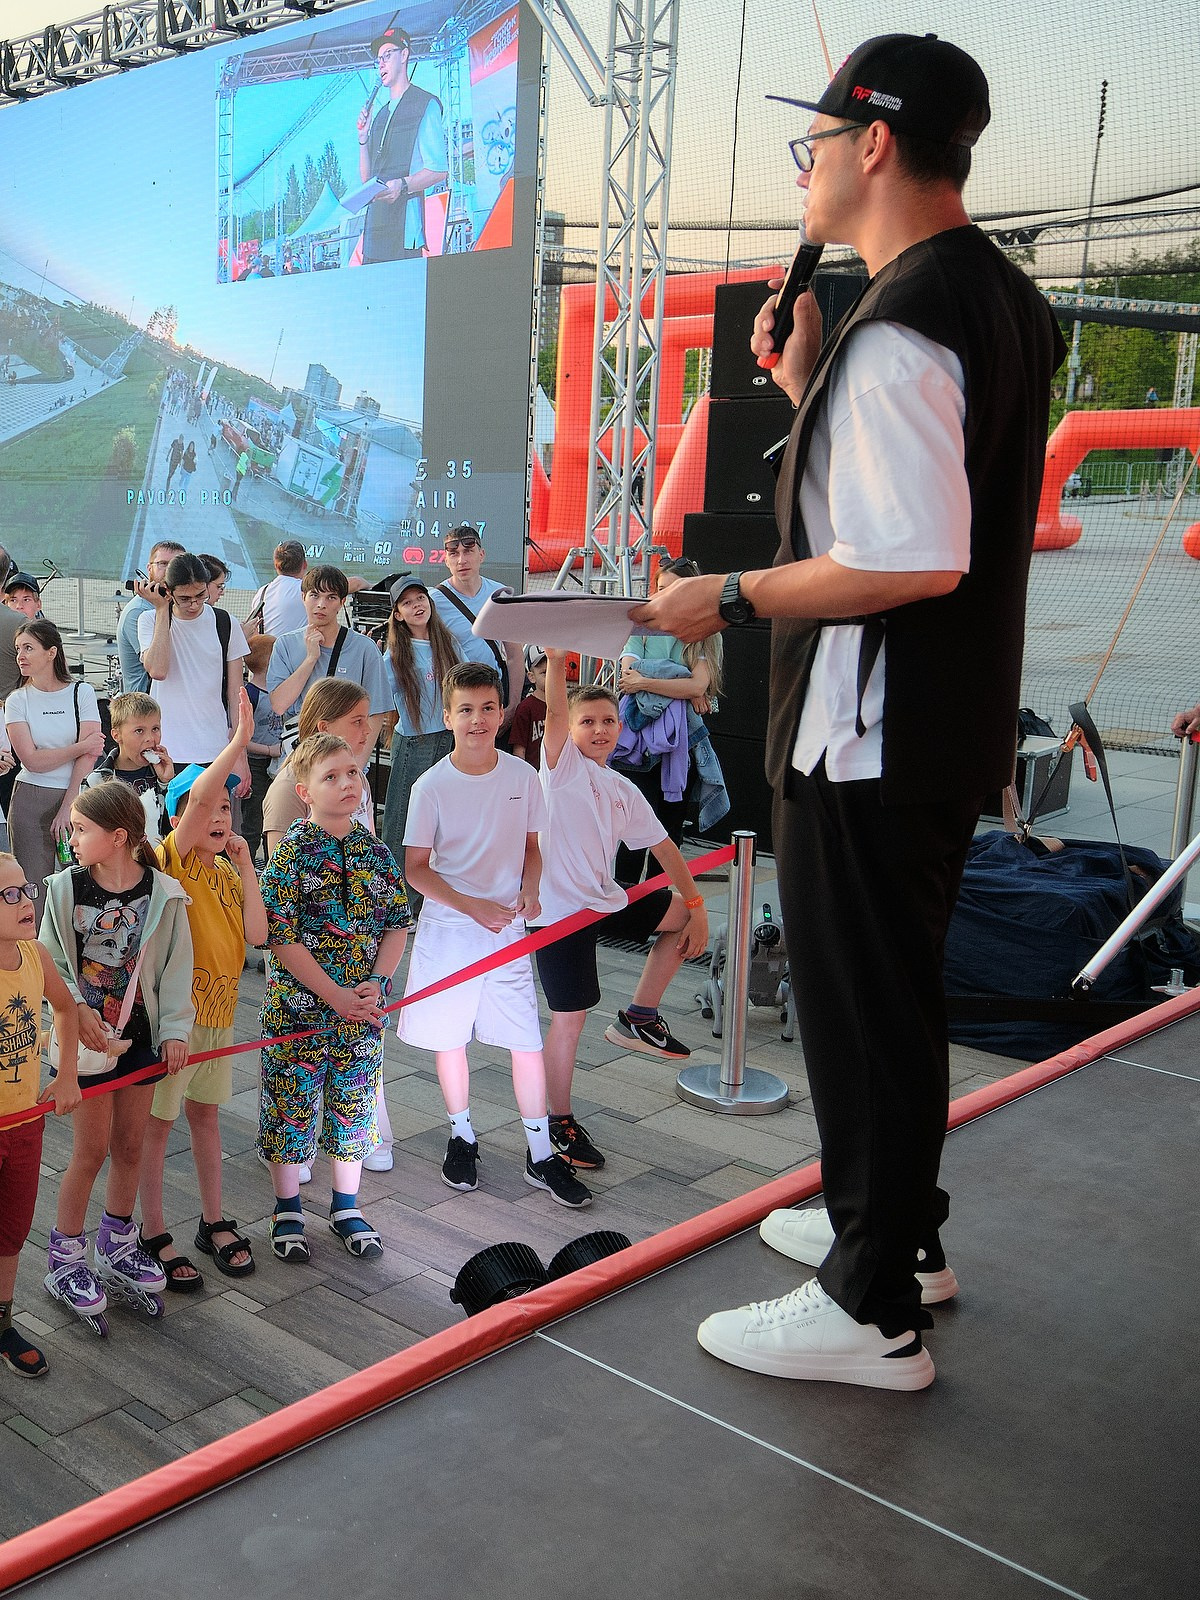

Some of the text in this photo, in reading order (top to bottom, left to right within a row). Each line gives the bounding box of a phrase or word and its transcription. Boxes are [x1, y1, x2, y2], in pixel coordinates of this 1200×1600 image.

[200, 489, 233, 506] PRO
[416, 490, 456, 509] AIR
[374, 541, 392, 555] 60
[3, 1030, 33, 1053] SHARK
[796, 1319, 817, 1329] GUESS
